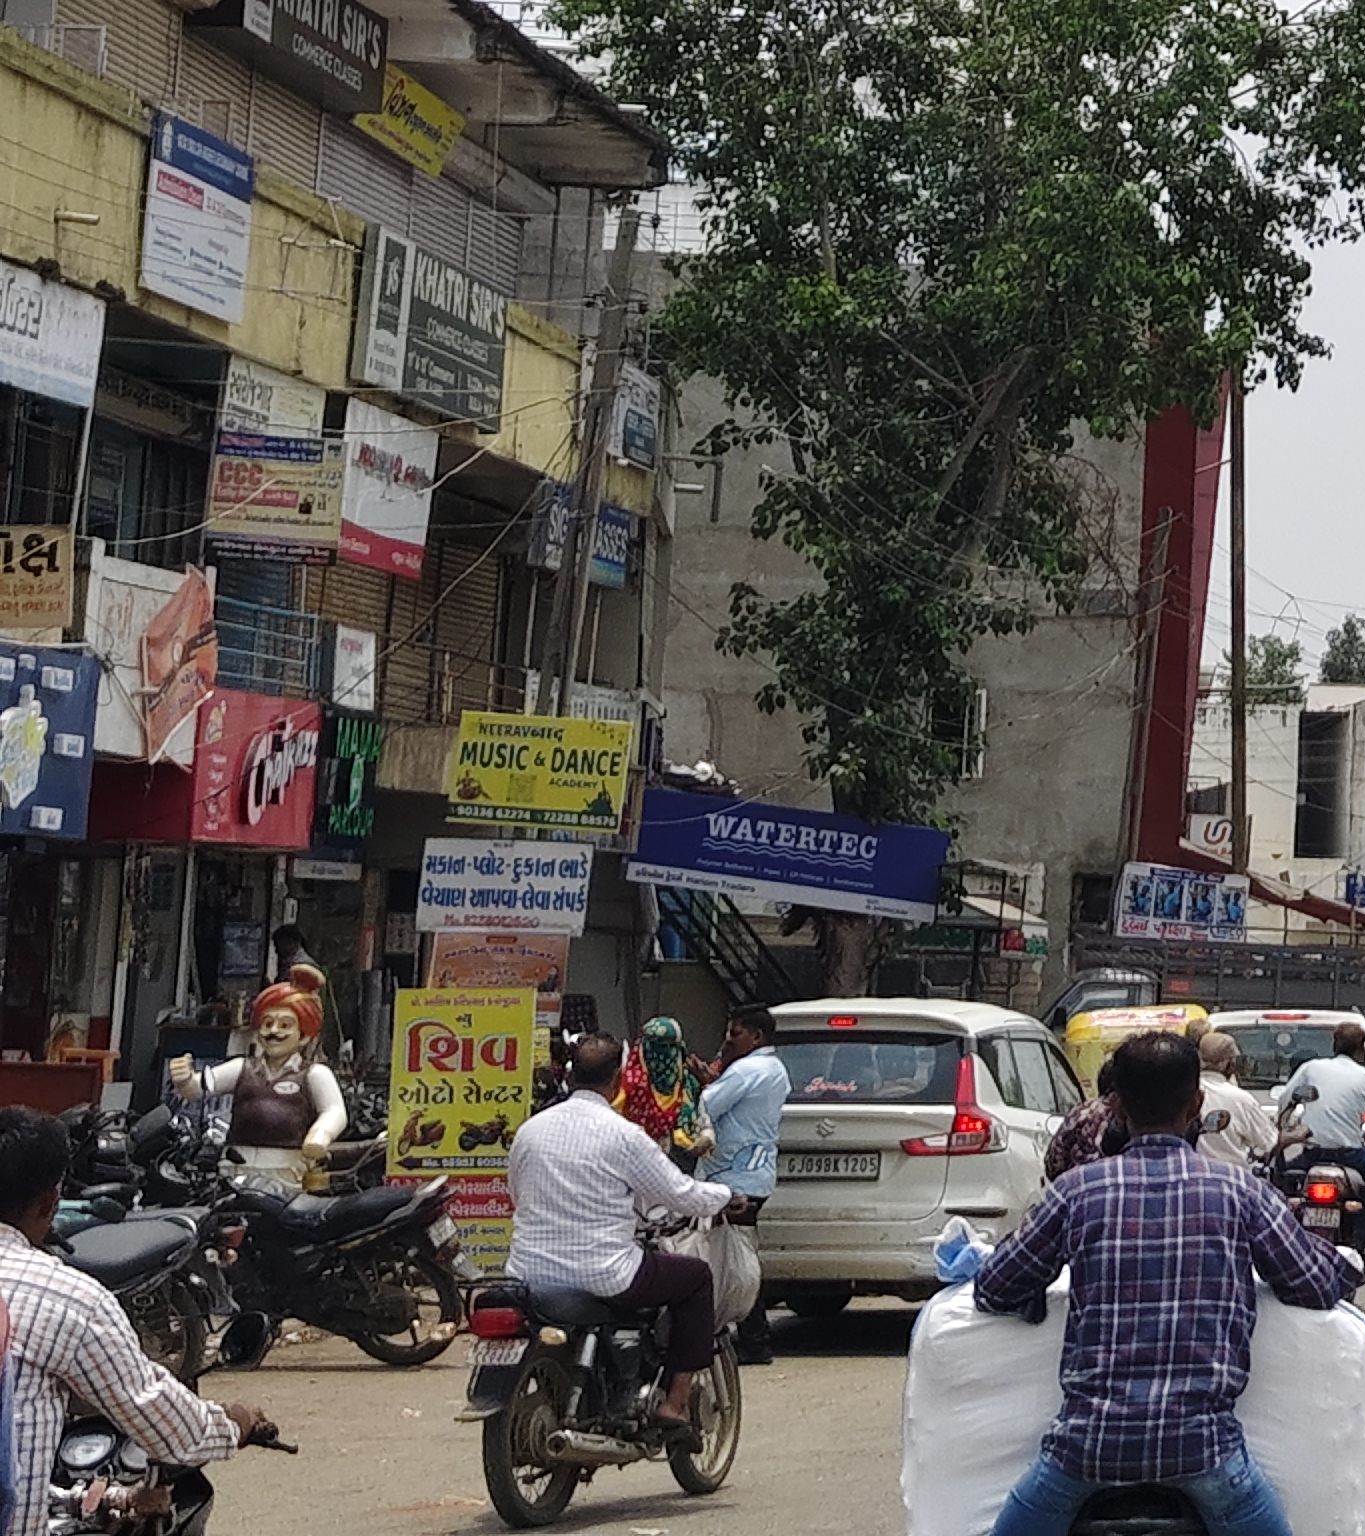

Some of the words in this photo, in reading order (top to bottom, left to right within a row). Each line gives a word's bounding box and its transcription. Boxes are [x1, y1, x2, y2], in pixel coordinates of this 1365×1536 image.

[341, 4, 382, 70] SIR'S
[413, 251, 470, 322] KHATRI
[459, 741, 530, 771] MUSIC
[534, 751, 546, 768] &
[551, 746, 622, 777] DANCE
[548, 778, 599, 790] ACADEMY
[704, 813, 879, 860] WATERTEC
[405, 1017, 521, 1074] શિવ
[398, 1077, 454, 1105] ઓટો
[462, 1077, 524, 1105] સેન્ટર
